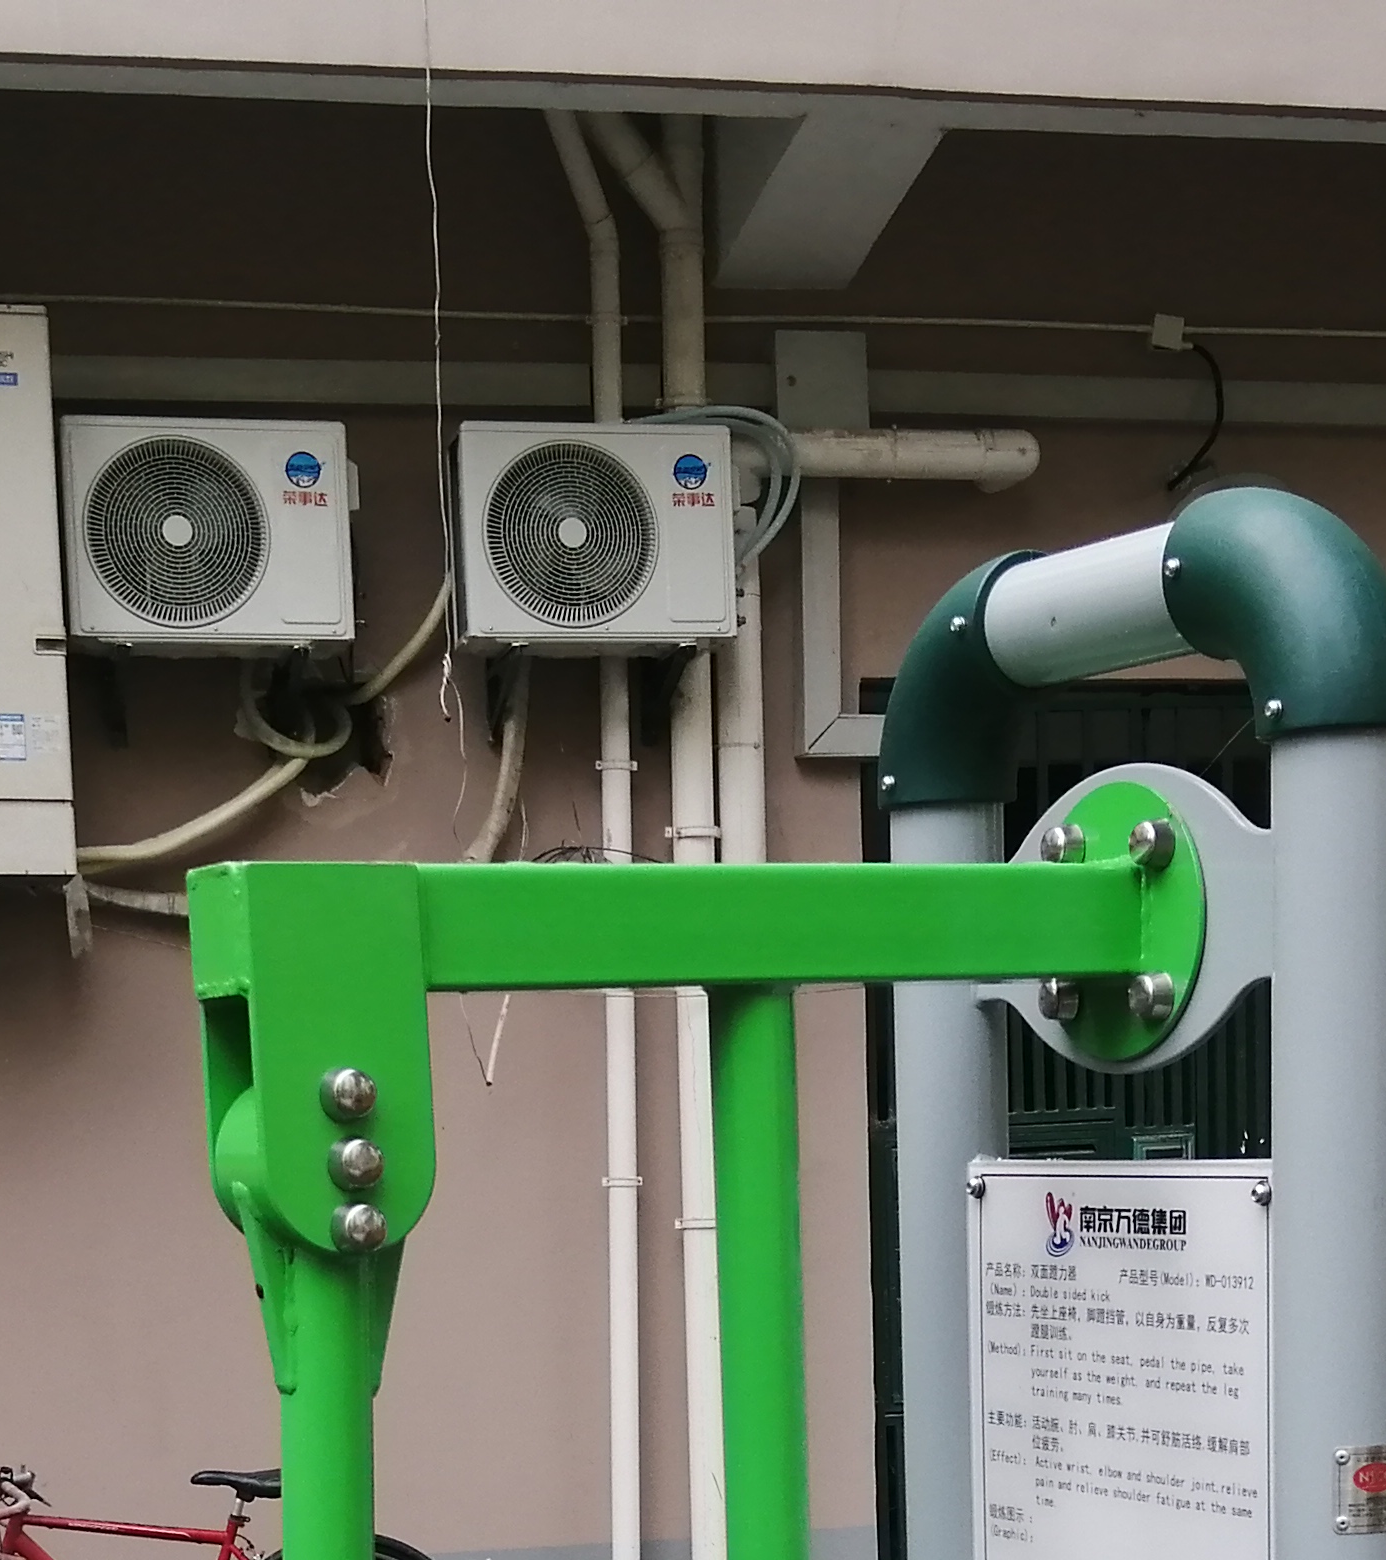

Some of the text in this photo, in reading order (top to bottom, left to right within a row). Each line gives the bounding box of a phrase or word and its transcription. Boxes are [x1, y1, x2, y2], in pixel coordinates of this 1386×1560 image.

[283, 490, 328, 507] 荣事达
[672, 492, 716, 507] 荣事达
[1079, 1205, 1187, 1236] 南京万德集团
[1079, 1235, 1187, 1252] NANJINGWANDEGROUP
[1029, 1284, 1059, 1300] Double
[1062, 1288, 1087, 1302] sided
[1090, 1289, 1111, 1303] kick
[1030, 1343, 1055, 1360] First
[1058, 1347, 1073, 1361] sit
[1076, 1351, 1088, 1362] on
[1091, 1350, 1106, 1364] the
[1139, 1355, 1164, 1369] pedal
[1170, 1358, 1186, 1371] the
[1222, 1362, 1245, 1377] take
[1031, 1366, 1068, 1379] yourself
[1072, 1371, 1083, 1382] as
[1086, 1370, 1102, 1384] the
[1145, 1376, 1161, 1390] and
[1165, 1380, 1197, 1394] repeat
[1201, 1381, 1218, 1395] the
[1223, 1383, 1240, 1400] leg
[1031, 1385, 1069, 1403] training
[1072, 1391, 1092, 1405] many
[1035, 1455, 1063, 1471] Active
[1098, 1465, 1123, 1479] elbow
[1126, 1470, 1142, 1483] and
[1145, 1471, 1186, 1488] shoulder
[1034, 1477, 1253, 1519] pain and relieve shoulder fatigue at the same
